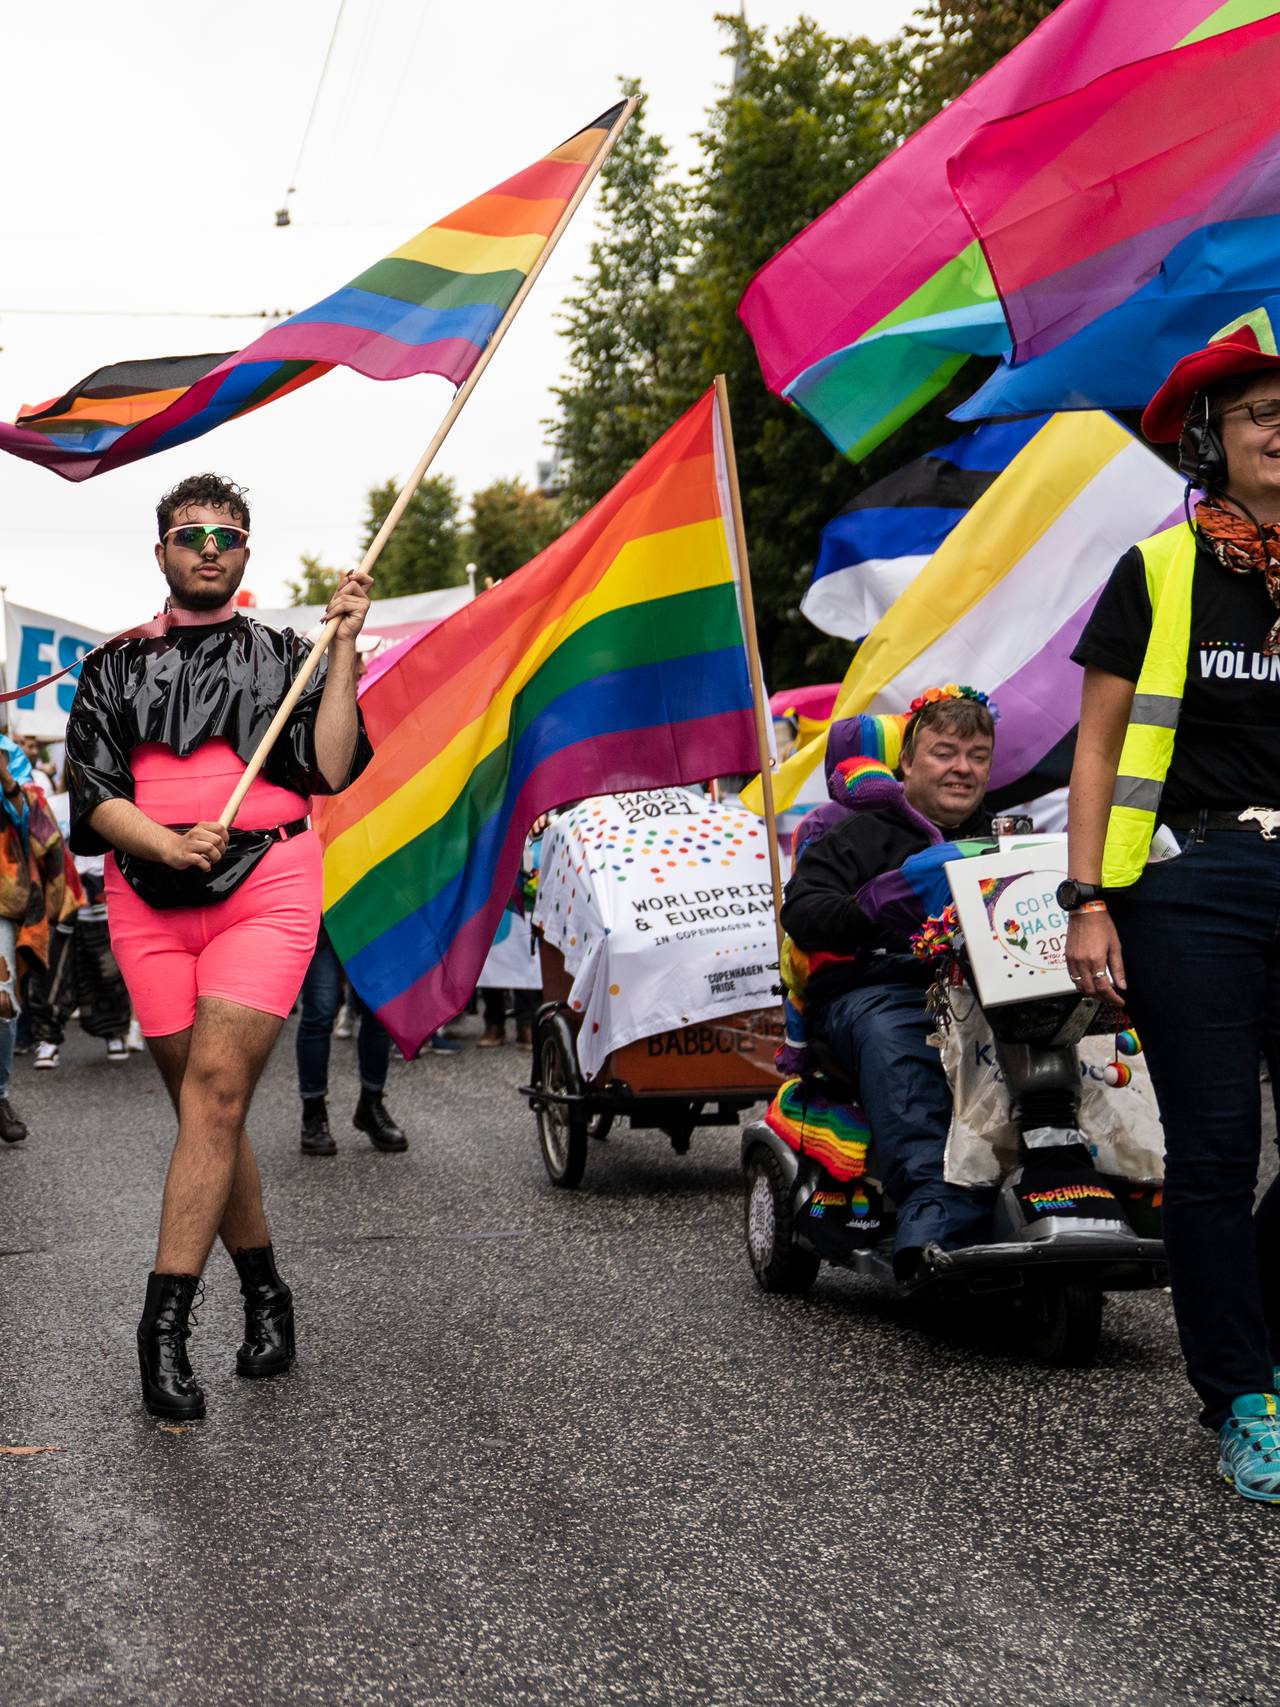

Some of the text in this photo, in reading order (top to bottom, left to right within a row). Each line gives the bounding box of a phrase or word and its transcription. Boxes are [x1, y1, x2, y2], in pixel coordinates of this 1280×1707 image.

[625, 800, 700, 824] 2021
[632, 882, 786, 913] WORLDPRID
[1016, 893, 1054, 916] COP
[635, 900, 774, 932] & EUROGAM
[1021, 911, 1069, 935] HAGE
[654, 936, 670, 947] IN
[676, 921, 751, 941] COPENHAGEN
[1036, 934, 1068, 955] 20
[710, 981, 736, 995] PRIDE
